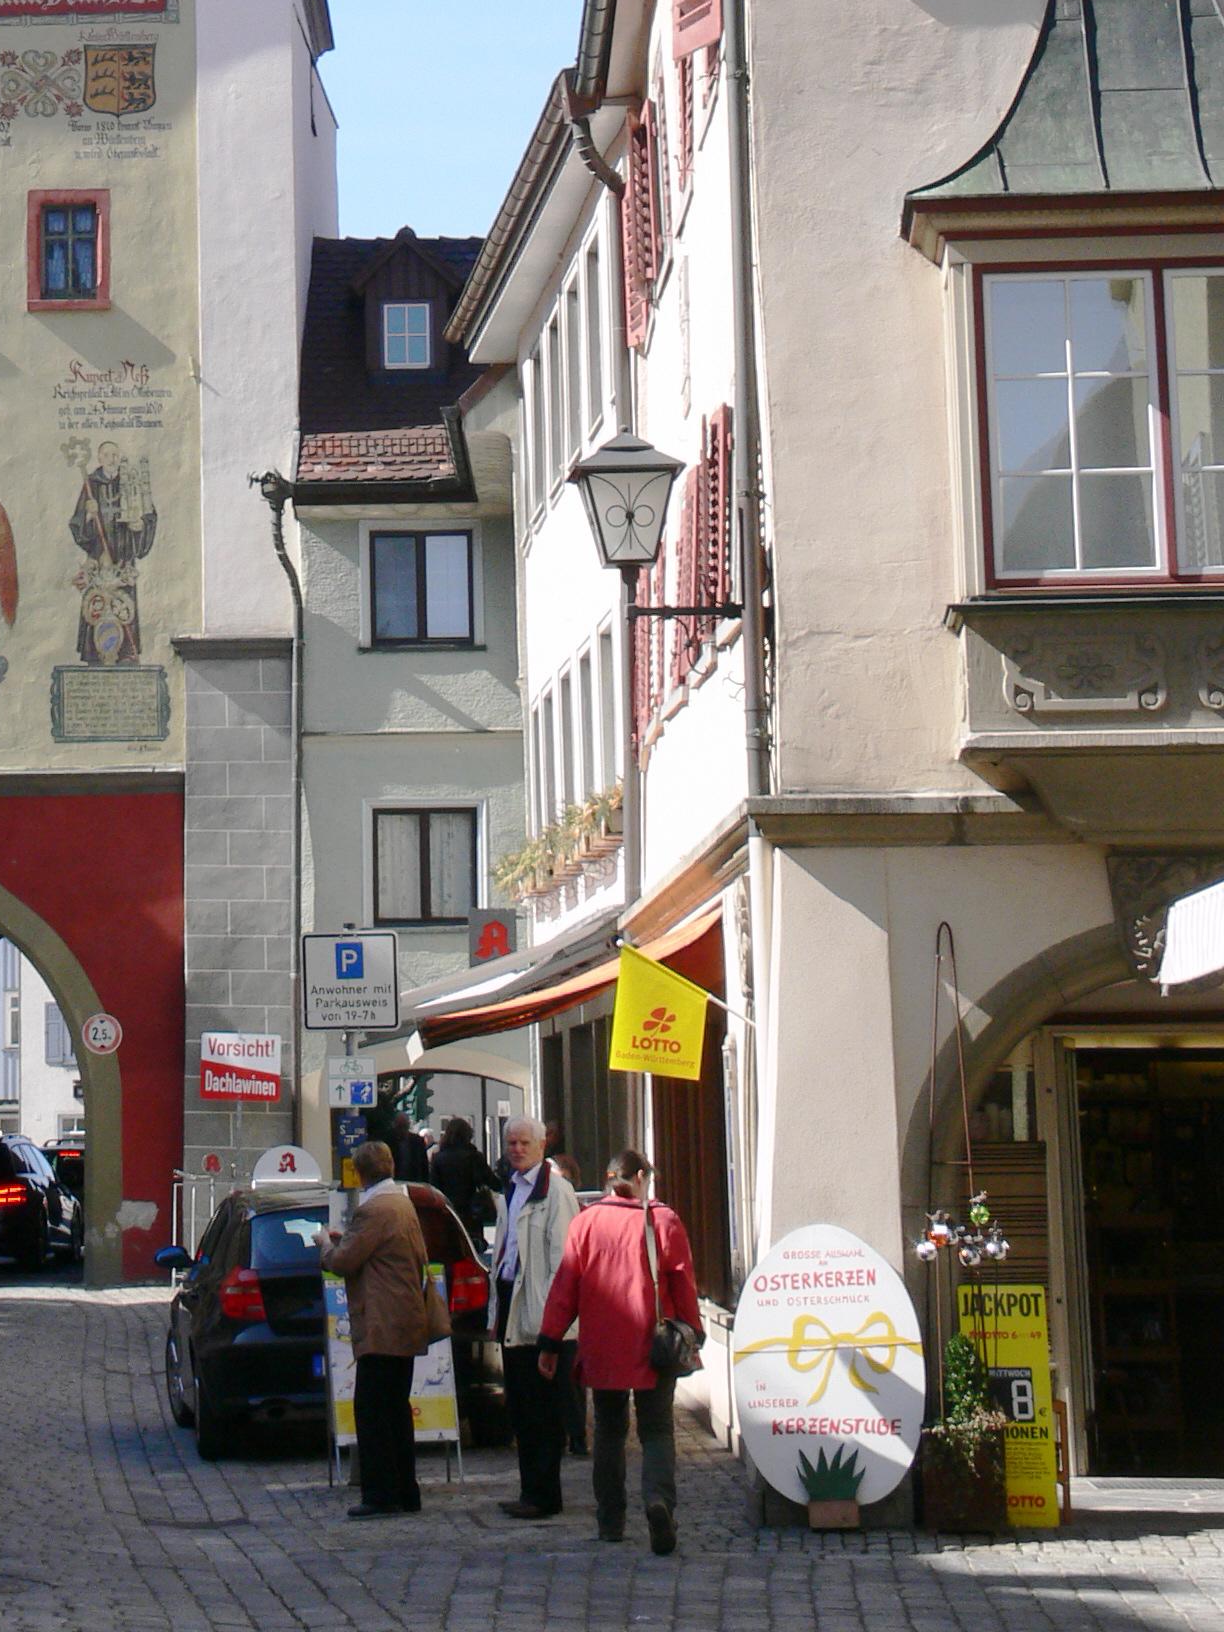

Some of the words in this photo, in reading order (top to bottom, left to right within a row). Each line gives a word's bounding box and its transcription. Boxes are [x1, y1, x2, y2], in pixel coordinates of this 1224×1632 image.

[341, 949, 358, 972] P
[311, 985, 368, 995] Anwohner
[373, 984, 392, 995] mit
[315, 998, 389, 1009] Parkausweis
[321, 1013, 342, 1021] von
[208, 1037, 275, 1058] Vorsicht!
[632, 1035, 681, 1053] LOTTO
[204, 1070, 276, 1097] Dachlawinen
[278, 1152, 297, 1174] A
[782, 1250, 821, 1260] GROSSE
[753, 1269, 877, 1293] OSTERKERZEN
[757, 1298, 779, 1307] UND
[787, 1294, 870, 1306] OSTERSCHMUCK
[961, 1292, 1042, 1317] JACKPOT
[748, 1399, 799, 1409] UNSERER
[1011, 1379, 1035, 1421] 8
[772, 1418, 902, 1436] KERZENSTUBE
[1007, 1495, 1046, 1508] OTTO
